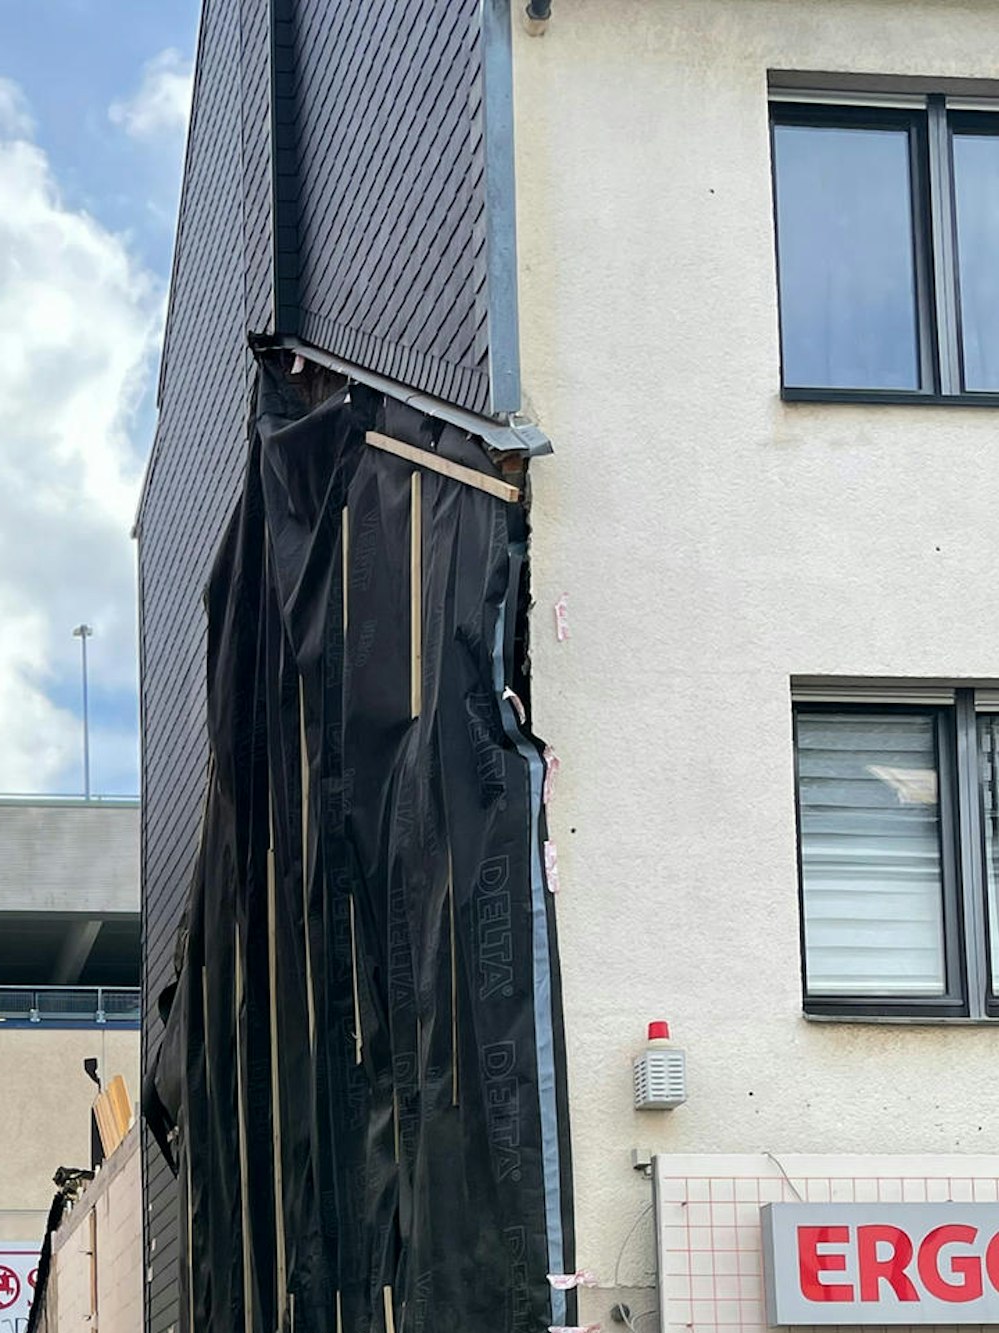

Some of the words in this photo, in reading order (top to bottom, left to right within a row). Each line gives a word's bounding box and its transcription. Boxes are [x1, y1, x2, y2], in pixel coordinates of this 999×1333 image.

[478, 855, 515, 1000] DELTA
[484, 1040, 522, 1182] DELTA
[797, 1224, 999, 1303] ERG
